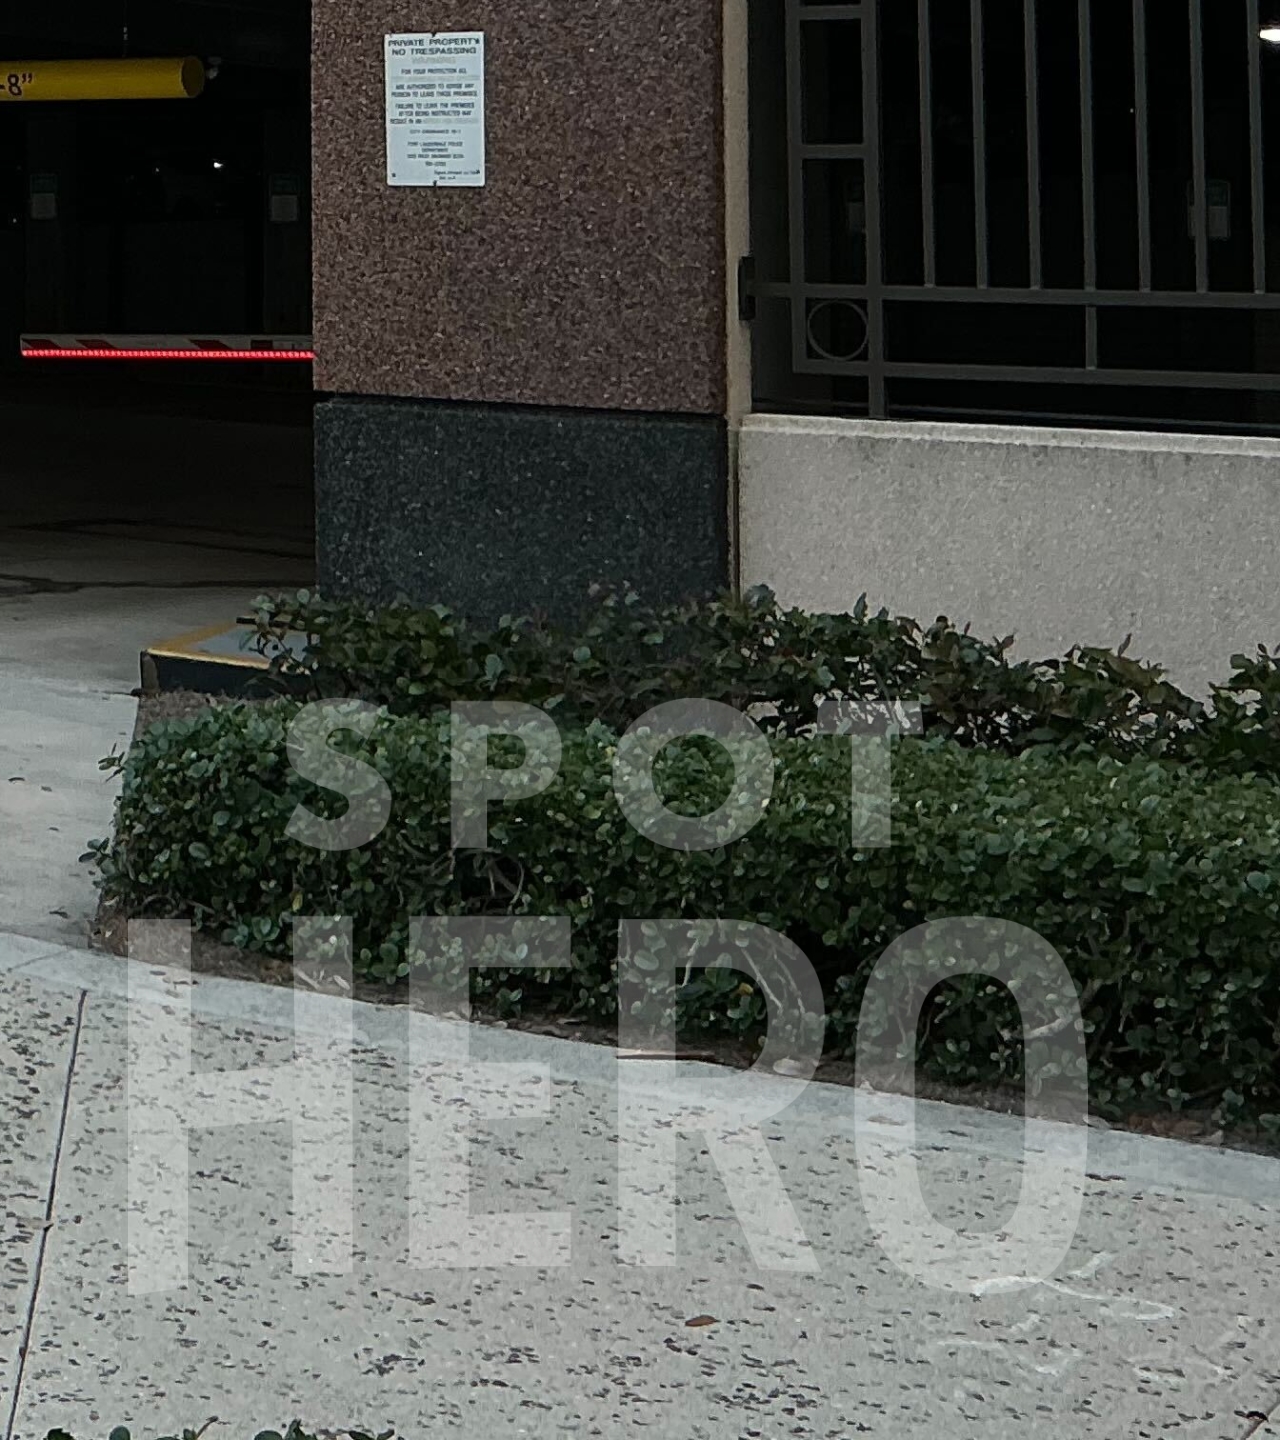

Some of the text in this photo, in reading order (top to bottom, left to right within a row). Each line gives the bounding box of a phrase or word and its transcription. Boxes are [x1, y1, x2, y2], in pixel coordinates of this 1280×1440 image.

[388, 38, 480, 46] PRIVATE PROPERTY
[392, 47, 477, 56] NO TRESPASSING
